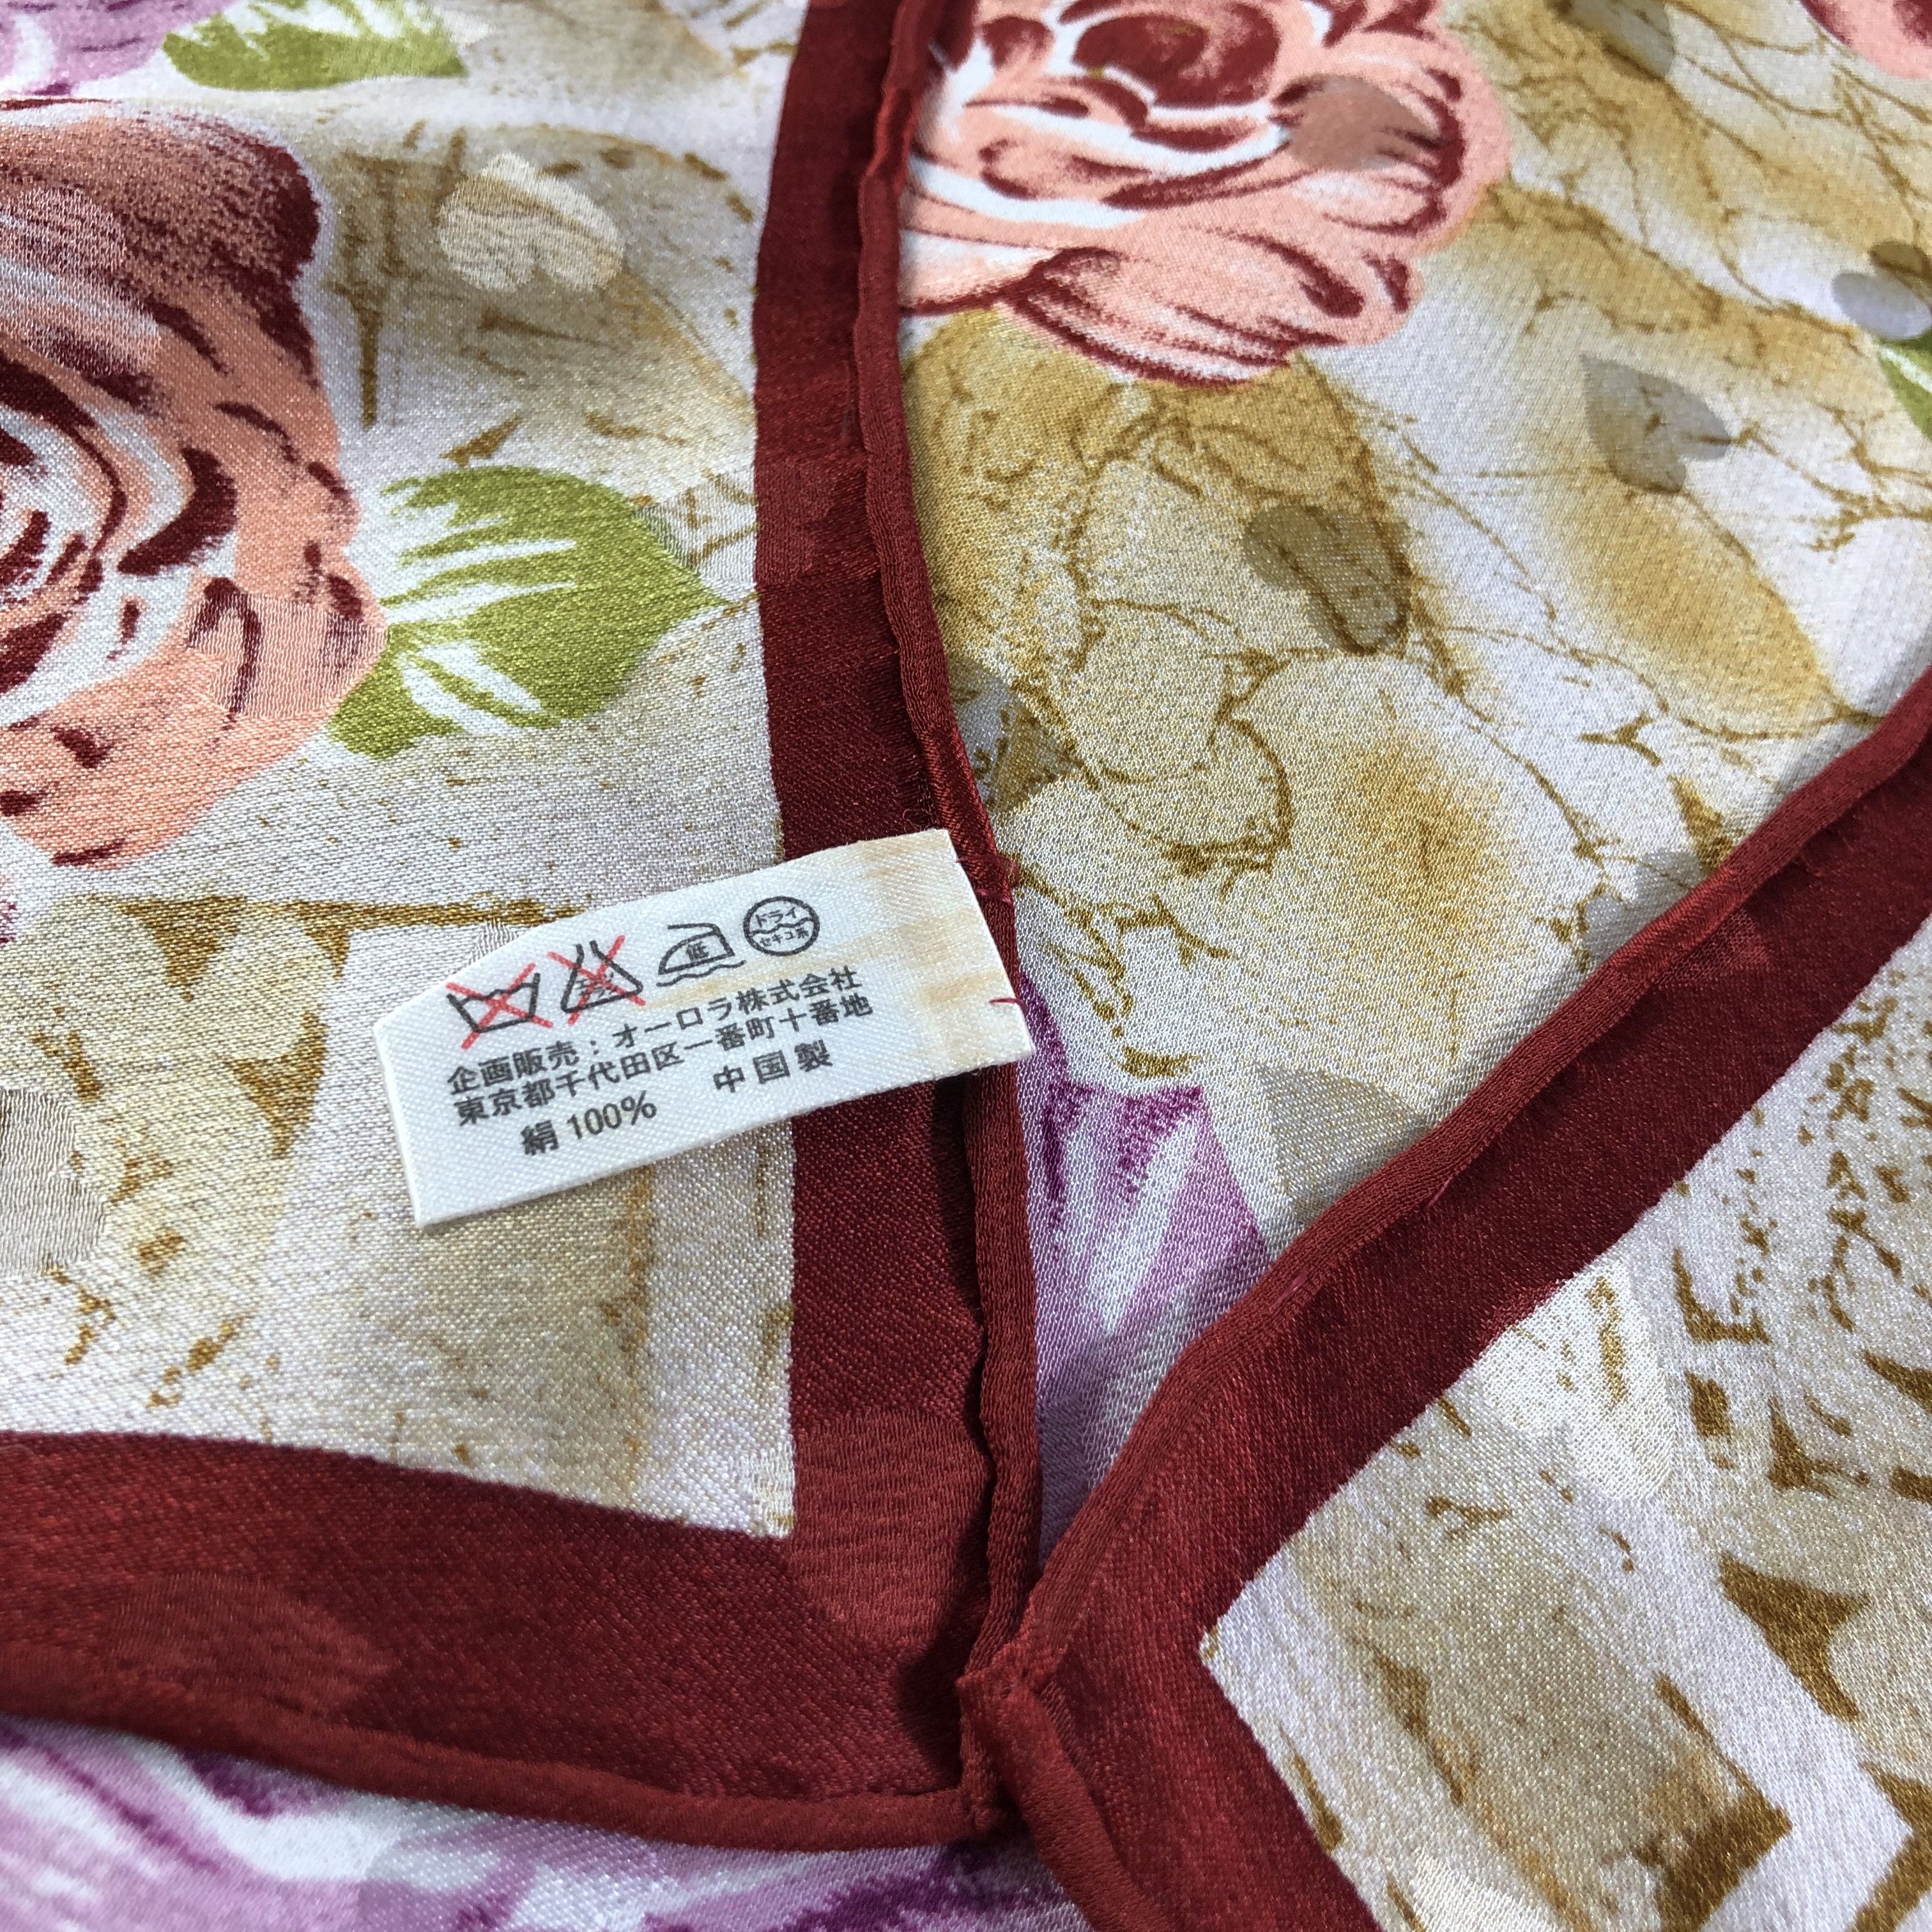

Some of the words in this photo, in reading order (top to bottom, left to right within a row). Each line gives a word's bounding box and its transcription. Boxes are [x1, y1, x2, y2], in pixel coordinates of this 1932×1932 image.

[686, 940, 710, 962] 低
[755, 906, 797, 927] ドライ
[454, 992, 873, 1126] 東京都千代田区一番町十番地
[520, 1119, 560, 1156] 絹
[567, 1090, 657, 1139] 100%
[713, 1039, 833, 1093] 中国製
